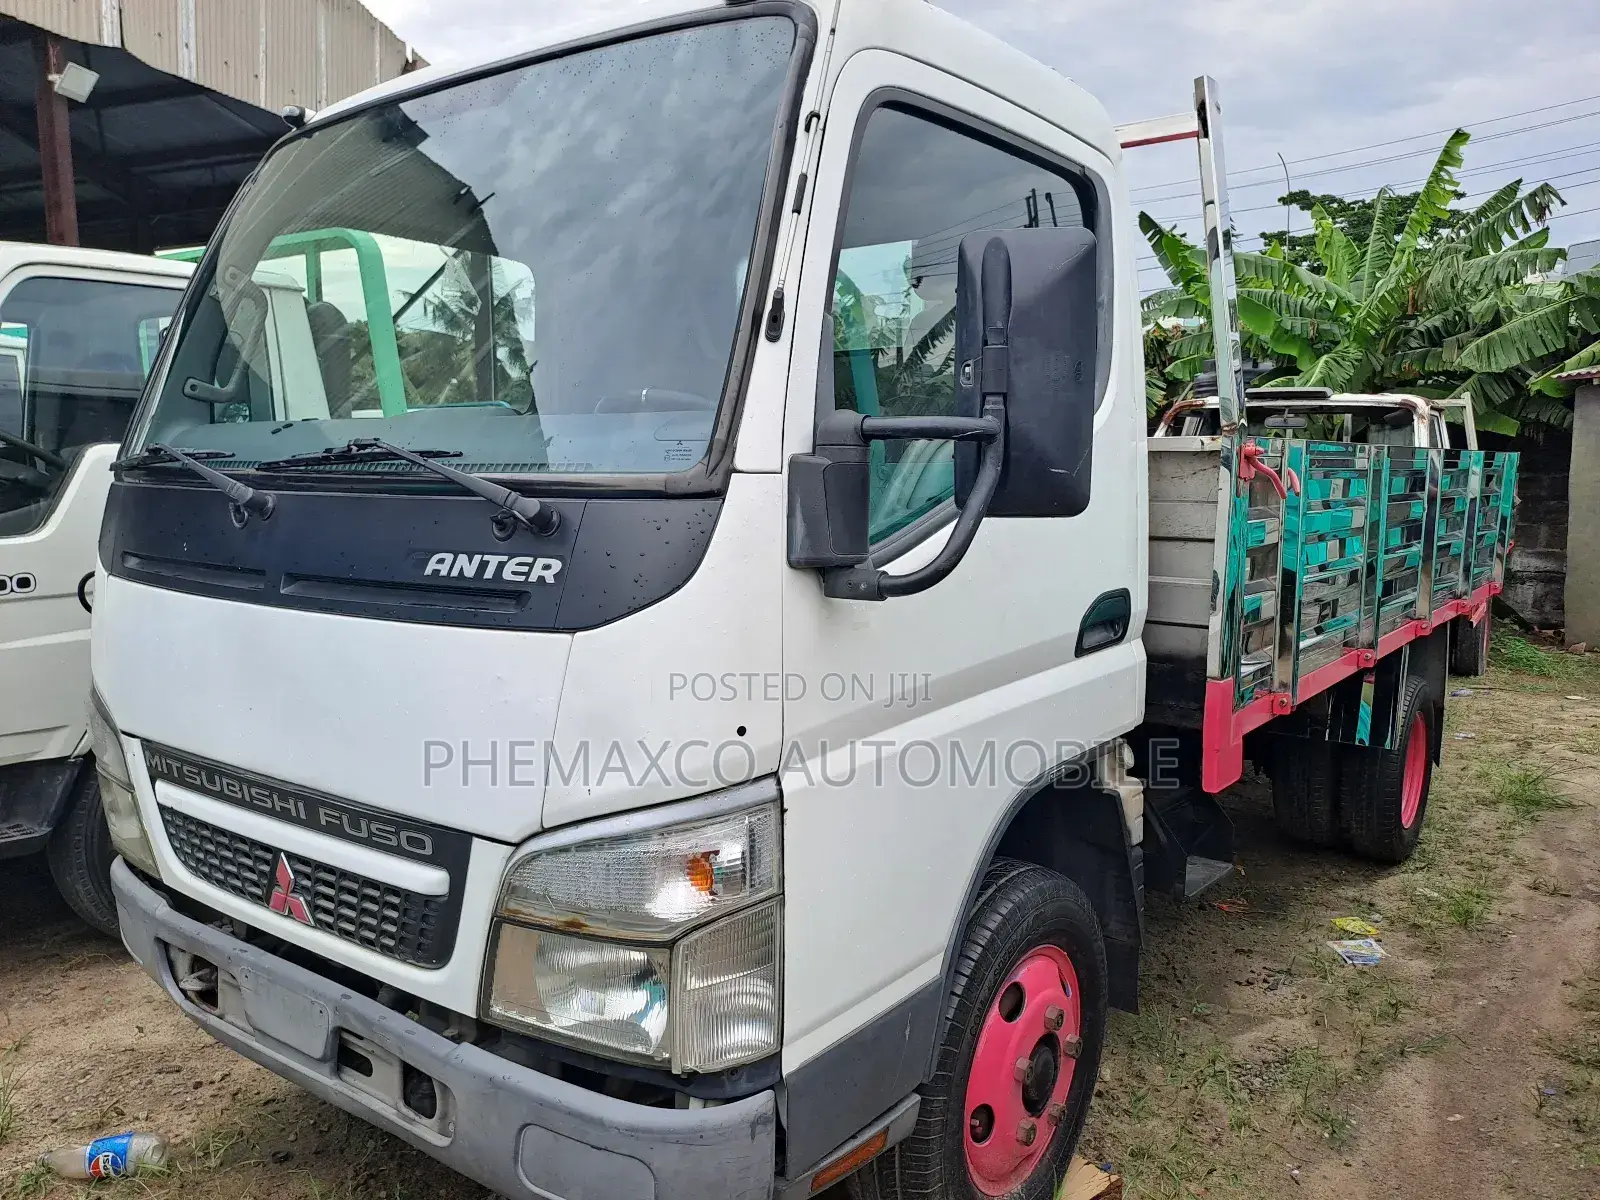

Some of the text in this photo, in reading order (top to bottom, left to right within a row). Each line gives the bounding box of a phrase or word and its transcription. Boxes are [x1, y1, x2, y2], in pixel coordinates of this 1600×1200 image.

[423, 552, 563, 584] ANTER
[145, 752, 434, 856] MITSUBISHI FUSO
